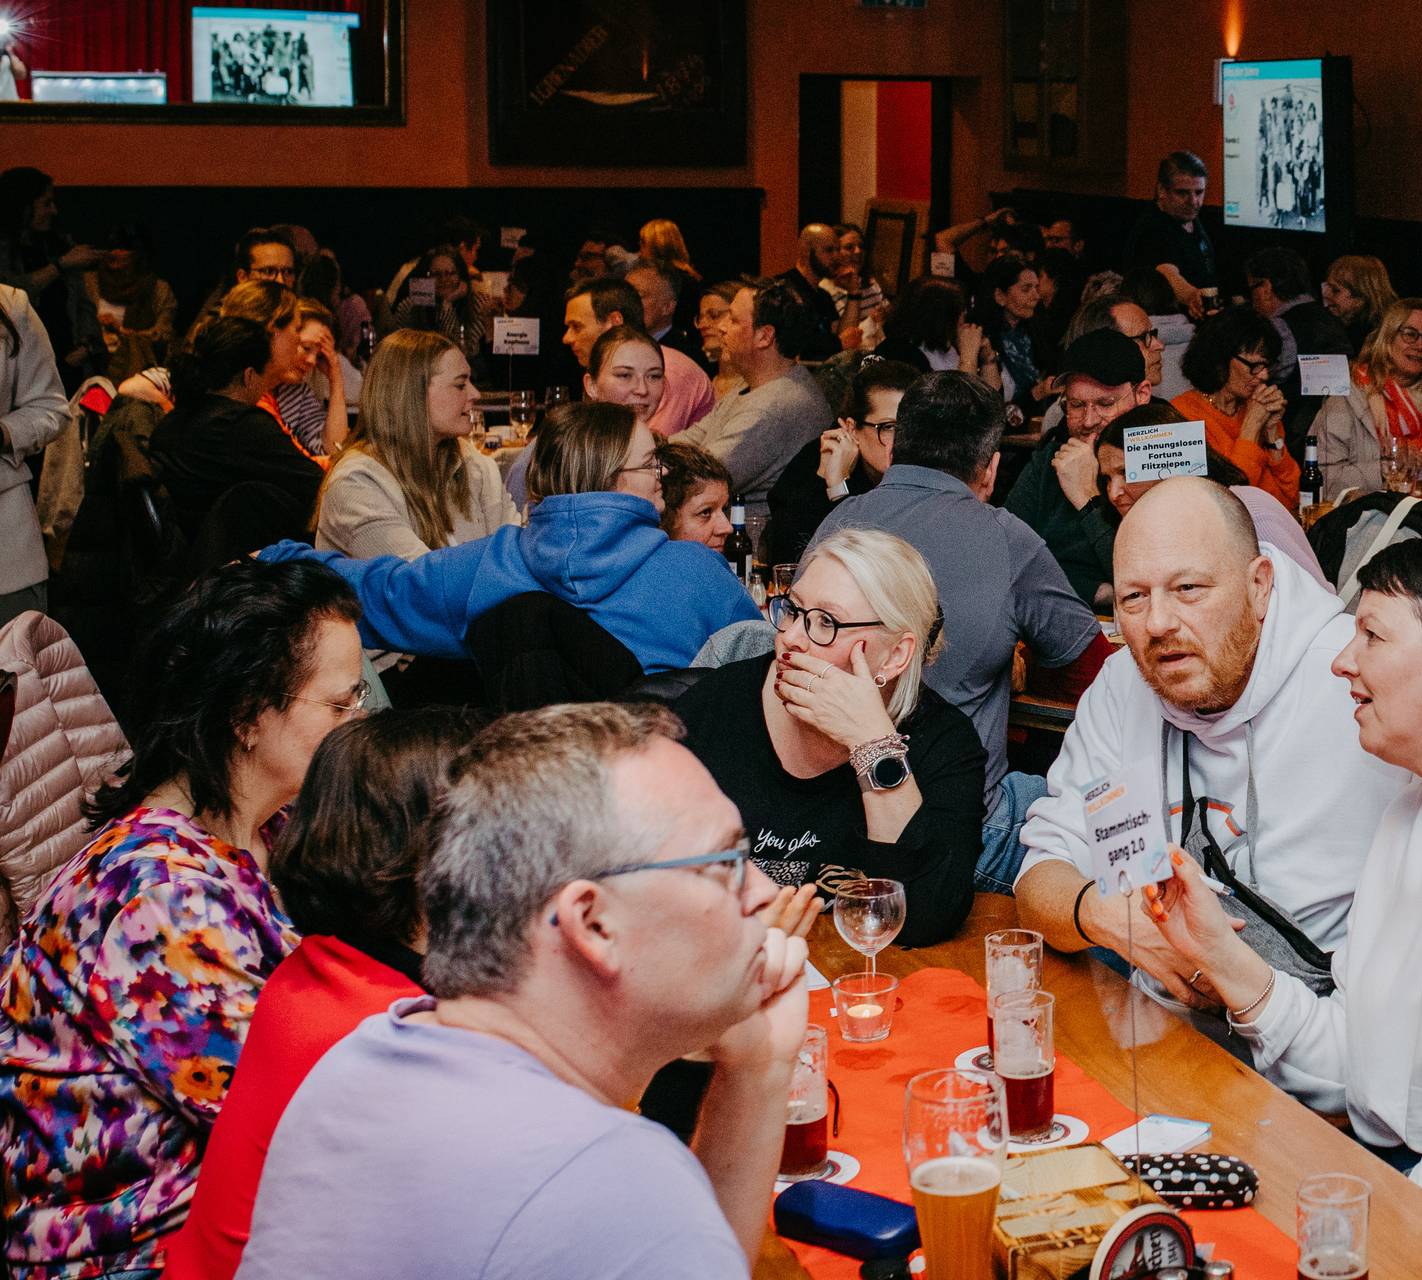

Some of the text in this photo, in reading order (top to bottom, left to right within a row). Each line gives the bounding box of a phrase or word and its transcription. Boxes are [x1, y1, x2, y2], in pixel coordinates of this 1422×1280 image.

[1127, 427, 1159, 438] HERZLICH
[1126, 439, 1203, 453] Die ahnungslosen
[1148, 451, 1183, 460] Fortuna
[1141, 460, 1191, 471] Flitzpiepen
[1095, 811, 1151, 842] Stammtisch-
[754, 828, 786, 853] You
[1108, 837, 1146, 866] gang 2.0
